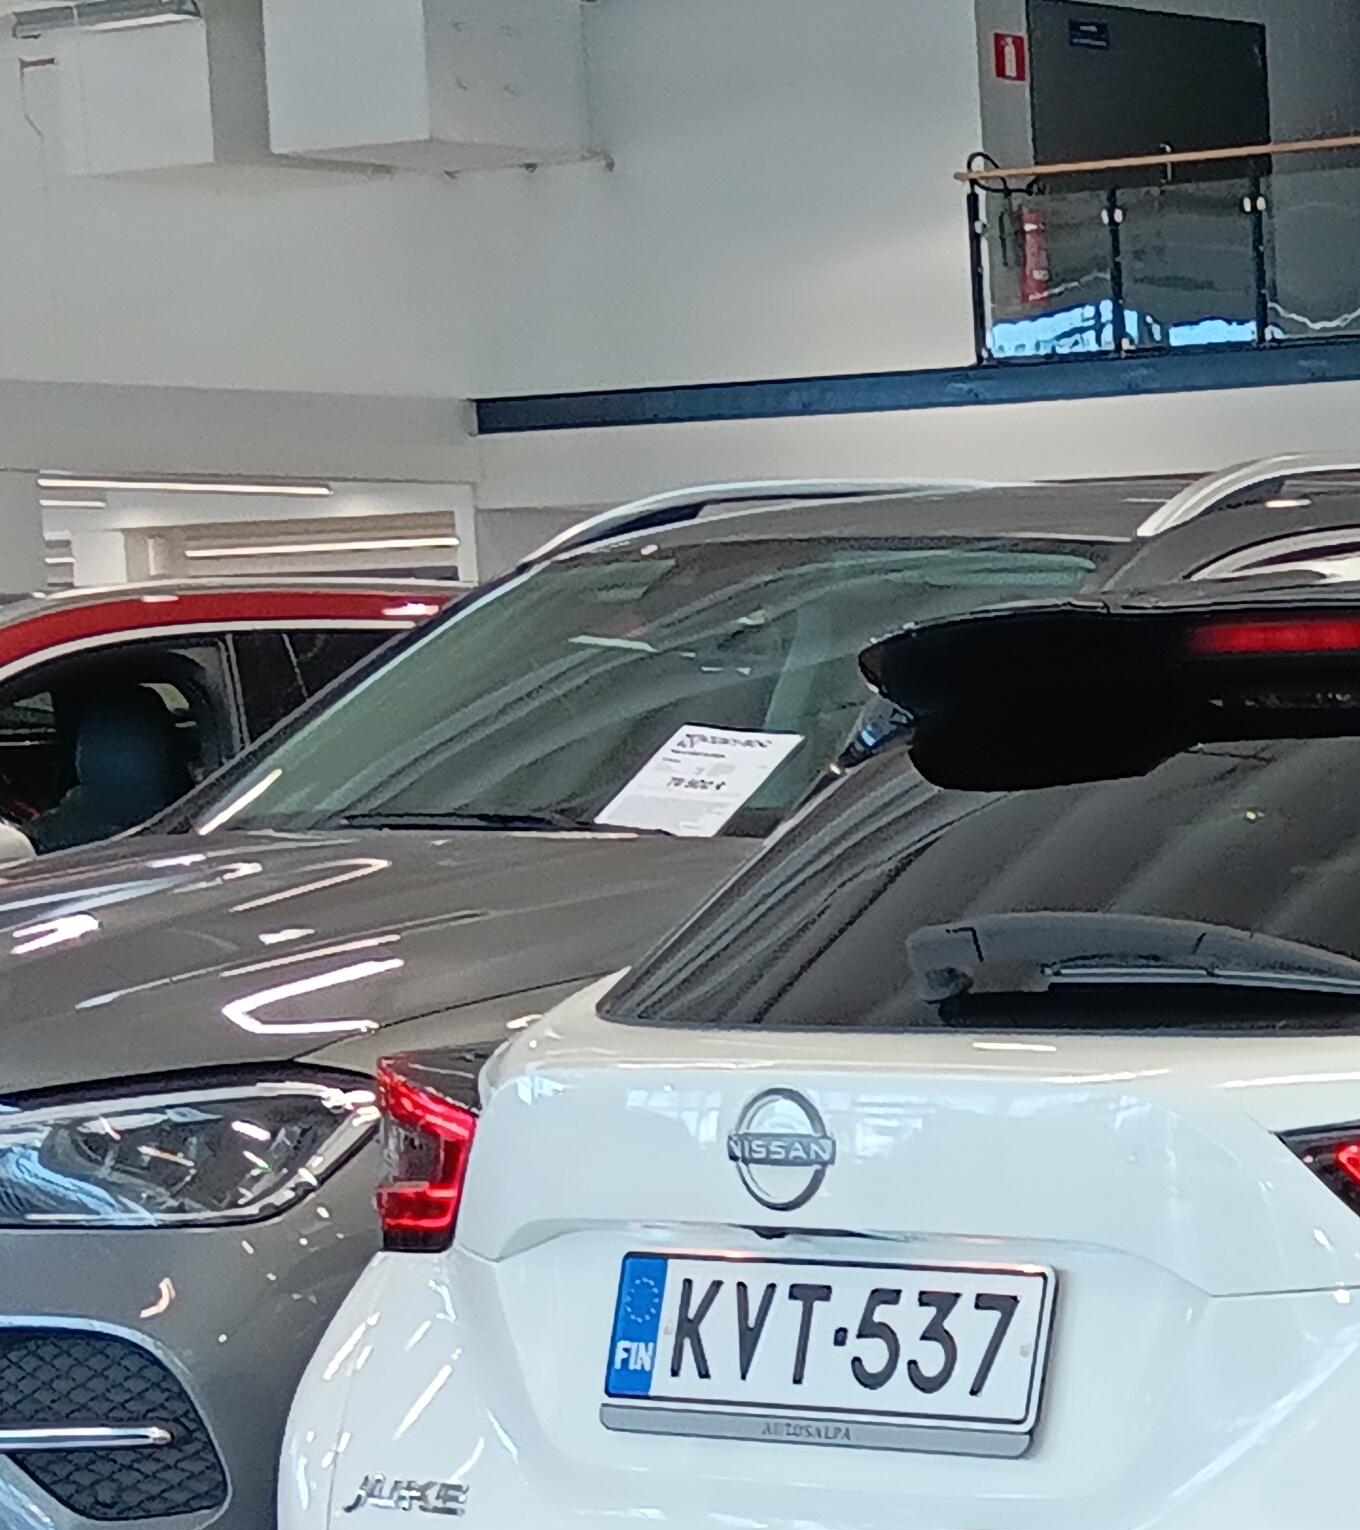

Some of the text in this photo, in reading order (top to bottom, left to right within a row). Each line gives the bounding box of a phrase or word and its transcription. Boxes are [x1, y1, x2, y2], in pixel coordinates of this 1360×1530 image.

[728, 1139, 833, 1161] NISSAN
[613, 1277, 1022, 1397] FIN KVT-537
[342, 1473, 469, 1516] JUKE
